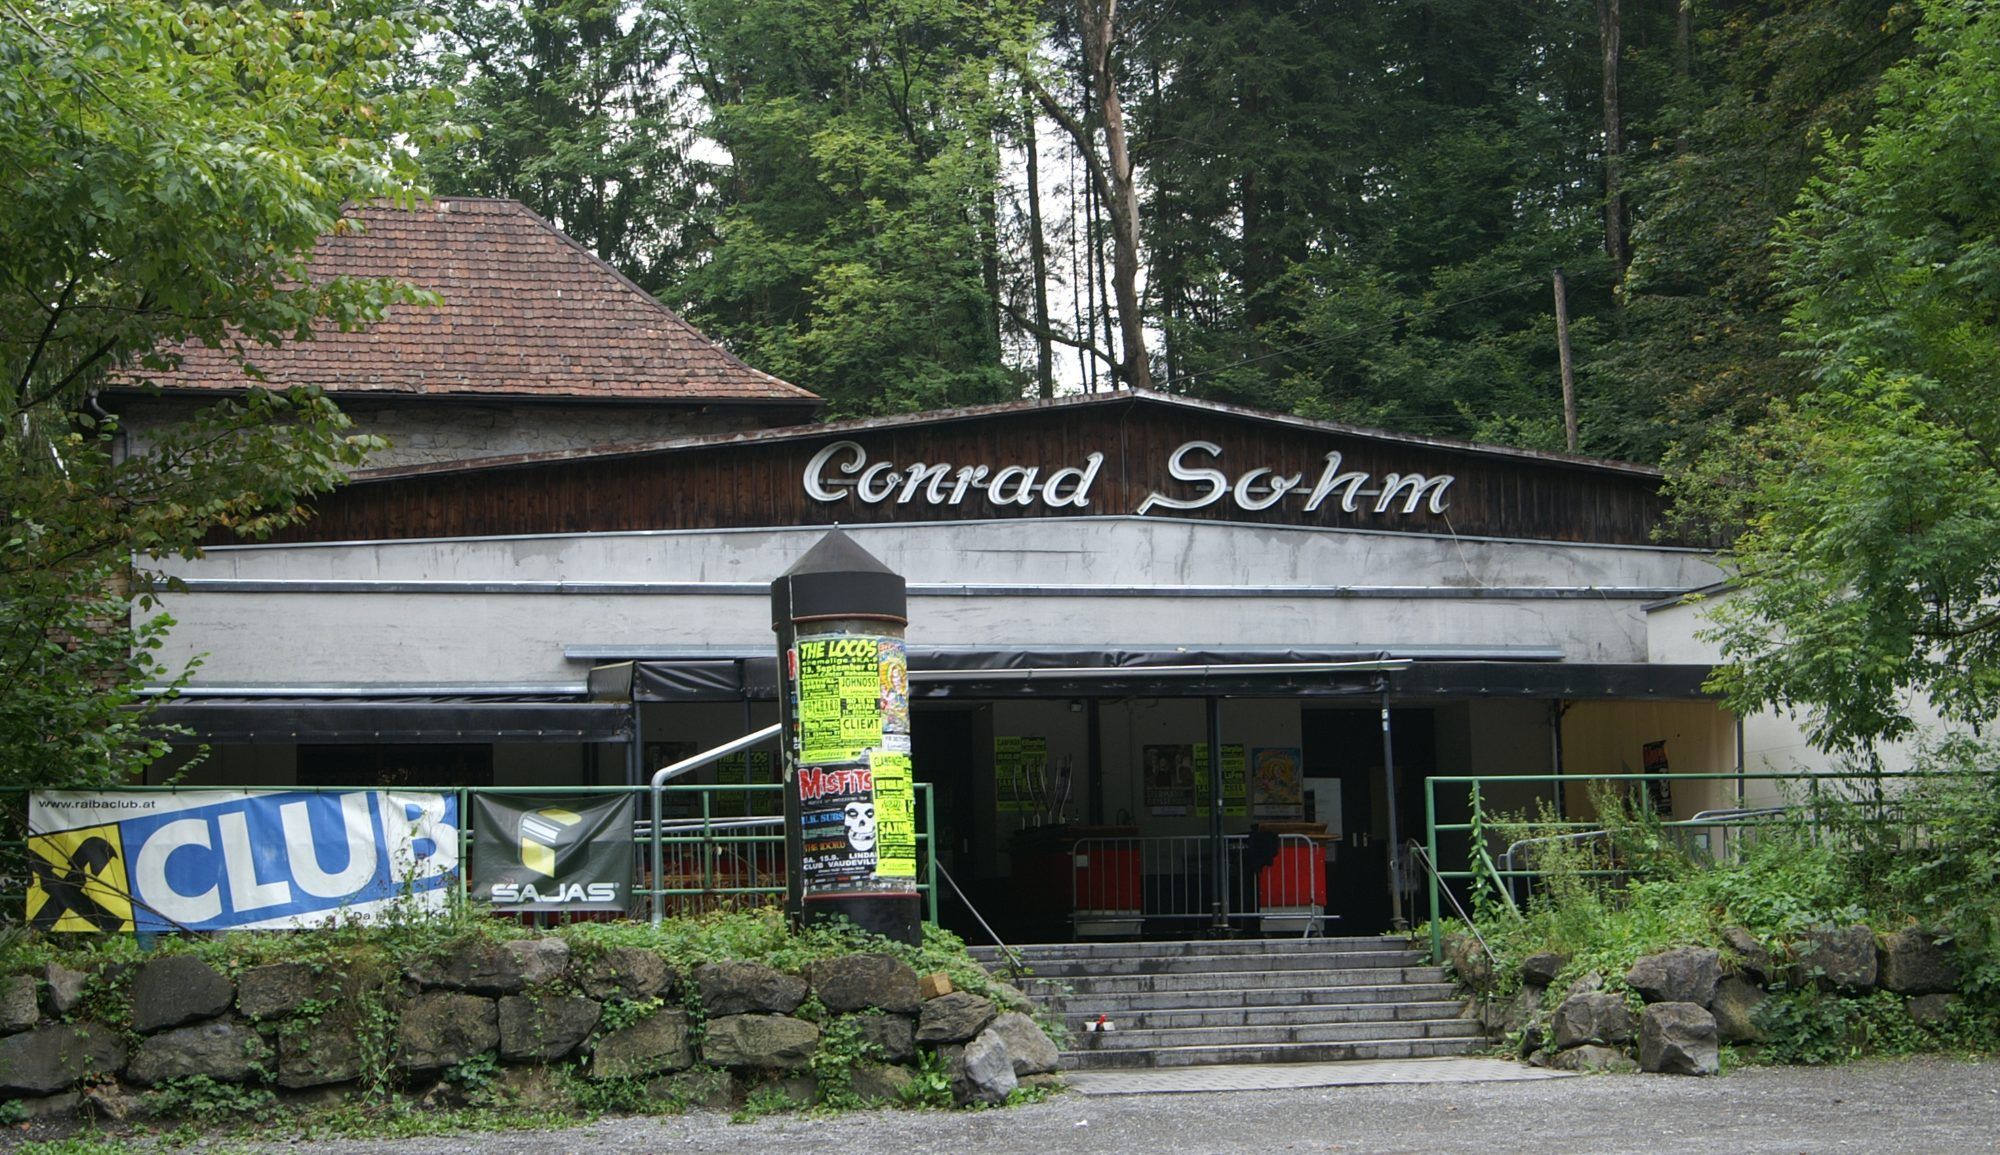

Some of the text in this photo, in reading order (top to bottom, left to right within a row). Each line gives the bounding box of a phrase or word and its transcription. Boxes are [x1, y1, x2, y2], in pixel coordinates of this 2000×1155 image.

[803, 439, 1455, 517] Conrad Sohm
[801, 642, 825, 659] THE
[828, 640, 877, 658] LOCOS
[39, 800, 156, 809] www.raibaclub.at
[136, 790, 460, 923] CLUB
[803, 862, 824, 870] CLUB
[828, 859, 877, 867] VAUDEVILL
